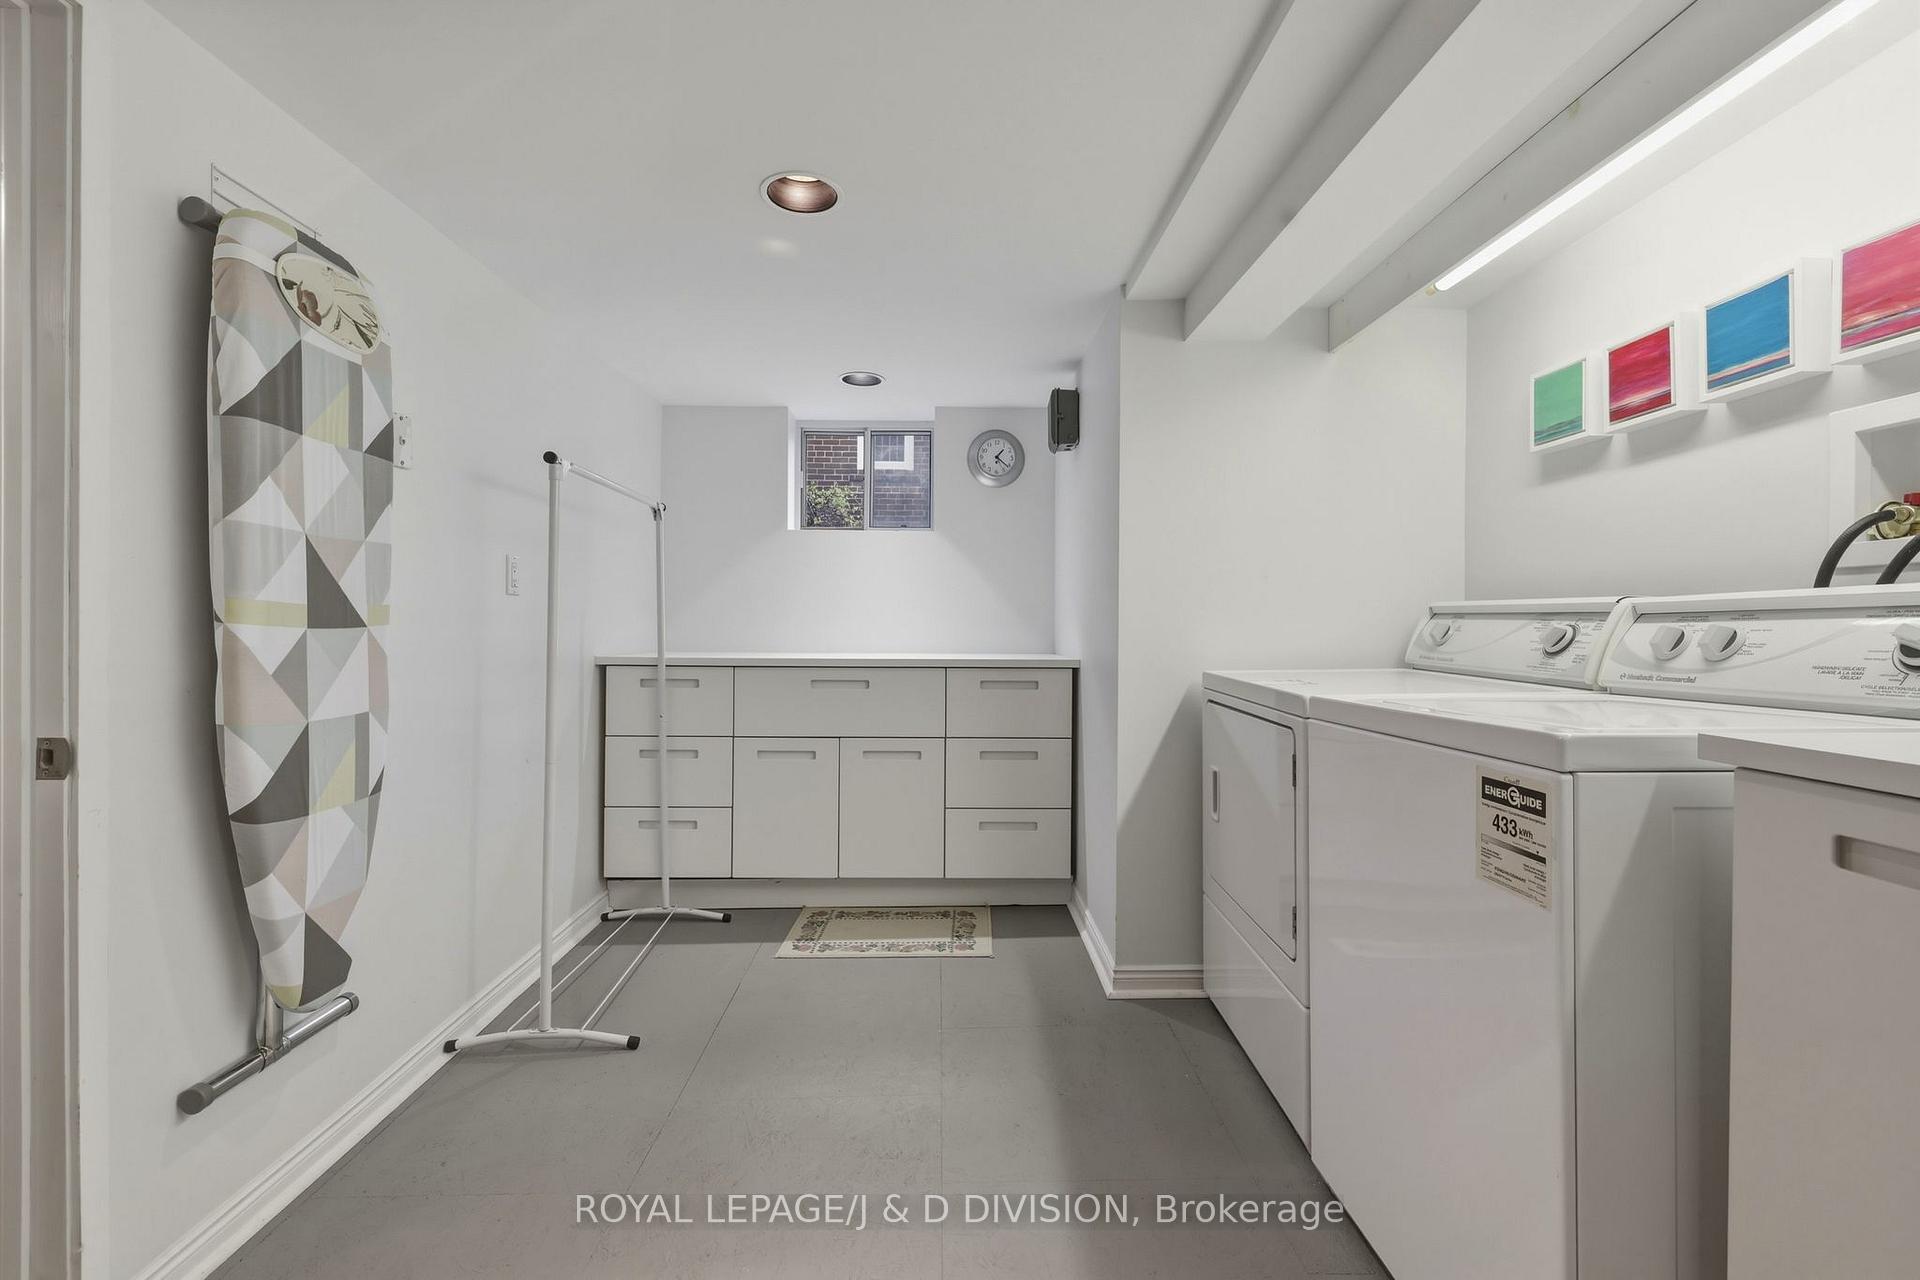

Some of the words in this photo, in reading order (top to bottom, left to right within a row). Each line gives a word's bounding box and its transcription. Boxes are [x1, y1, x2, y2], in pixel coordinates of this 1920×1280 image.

[1484, 784, 1543, 811] ENERGUIDE
[1492, 813, 1518, 838] 433
[1519, 828, 1534, 840] kWh
